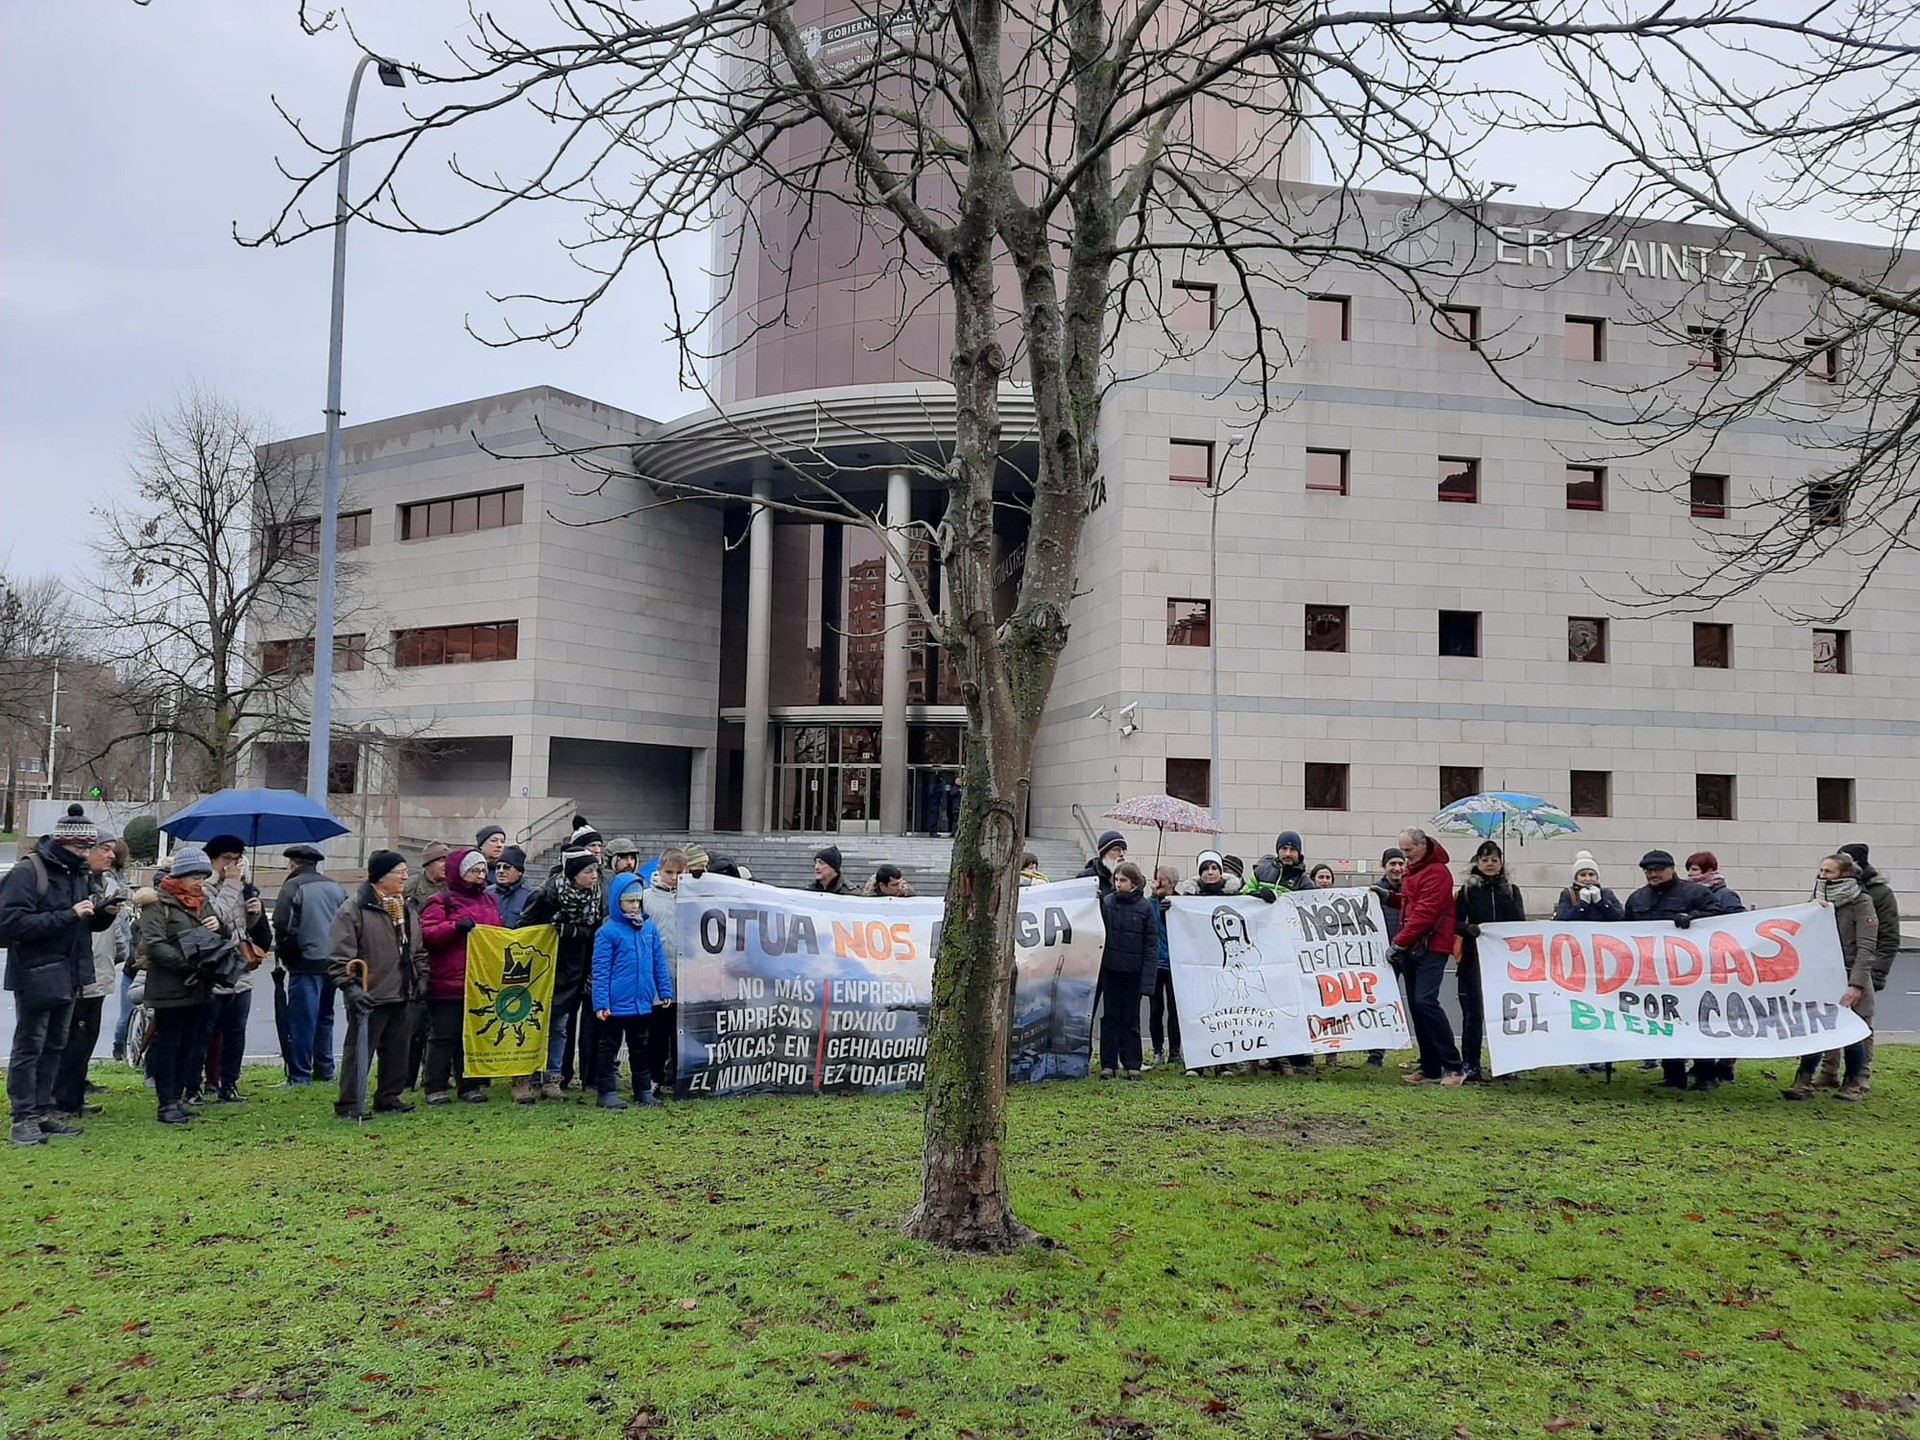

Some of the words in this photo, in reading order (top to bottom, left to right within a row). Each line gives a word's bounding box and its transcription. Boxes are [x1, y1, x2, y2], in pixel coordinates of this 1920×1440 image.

[1495, 225, 1778, 291] ERTZAINTZA
[1296, 892, 1379, 942] NORK
[700, 908, 820, 956] OTUA
[831, 920, 916, 961] NOS
[1502, 918, 1802, 995] JODIDAS
[738, 977, 765, 1000] NO
[774, 975, 815, 1003] MÁS
[832, 980, 916, 1004] ENPRESA
[1315, 970, 1378, 1007] DU?
[716, 1004, 814, 1035] EMPRESAS
[831, 1010, 898, 1032] TOXIKO
[1503, 992, 1550, 1036] EL
[1698, 988, 1840, 1040] COMÚN
[1618, 990, 1683, 1022] POR
[704, 1033, 777, 1066] TÓXICAS
[784, 1035, 810, 1058] EN
[1210, 1035, 1270, 1058] OTUA
[689, 1071, 711, 1091] EL
[715, 1060, 808, 1091] MUNICIPIO
[823, 1063, 847, 1085] EZ
